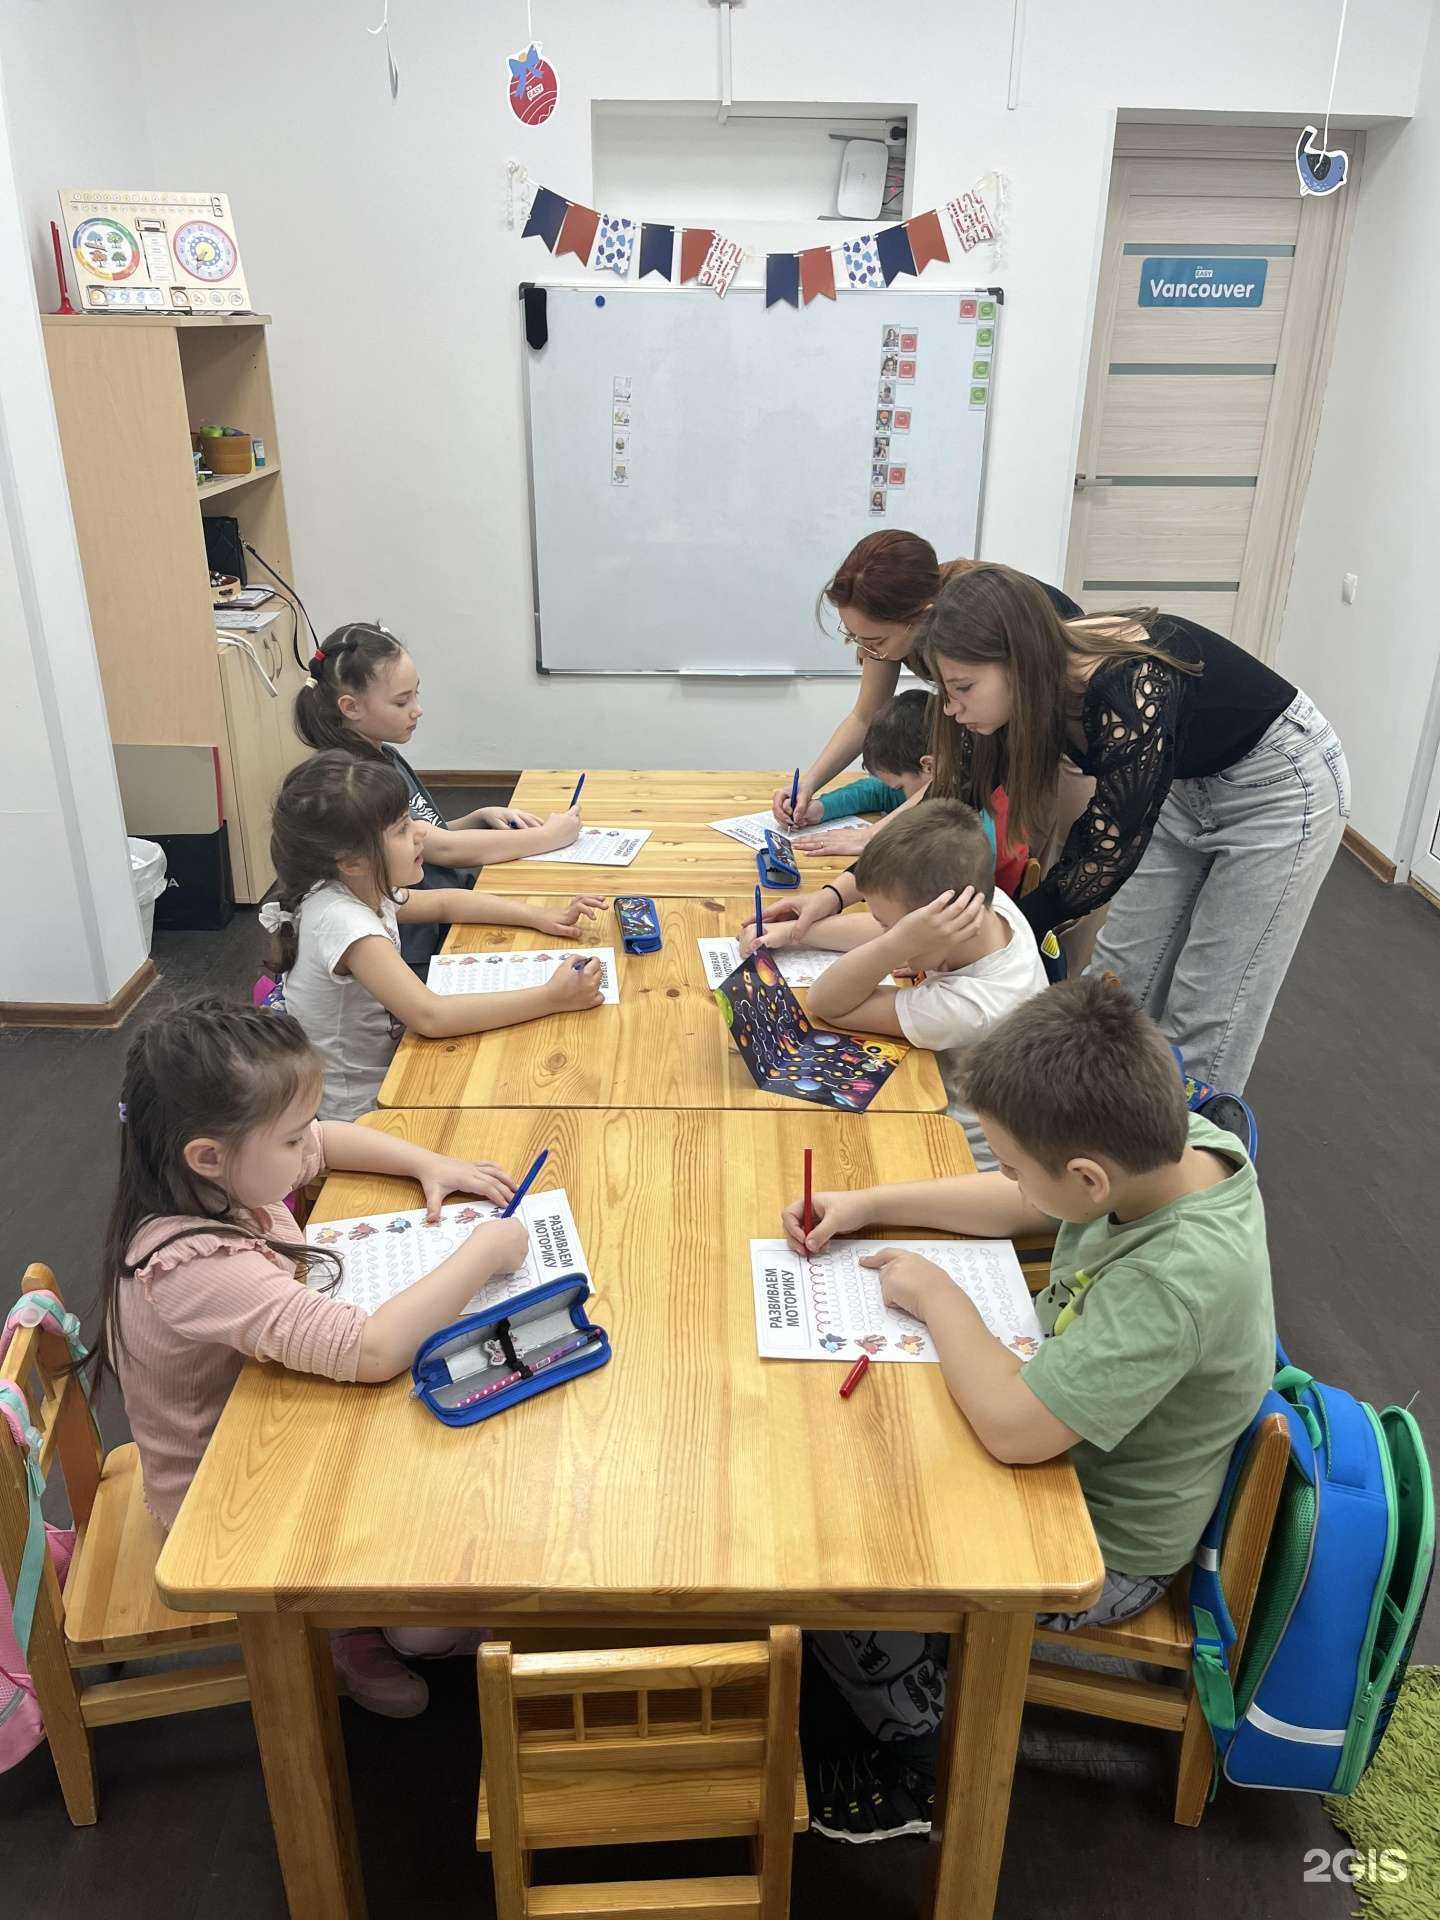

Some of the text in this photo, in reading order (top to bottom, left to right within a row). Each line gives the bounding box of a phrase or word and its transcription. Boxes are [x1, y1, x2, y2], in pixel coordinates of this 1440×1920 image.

[527, 85, 543, 98] EASY
[1150, 279, 1255, 298] Vancouver
[533, 1219, 558, 1268] МОТОРИКУ
[549, 1214, 574, 1268] РАЗВИВАЕМ
[765, 1268, 783, 1329] РАЗВИВАЕМ
[781, 1270, 800, 1328] МОТОРИКУ
